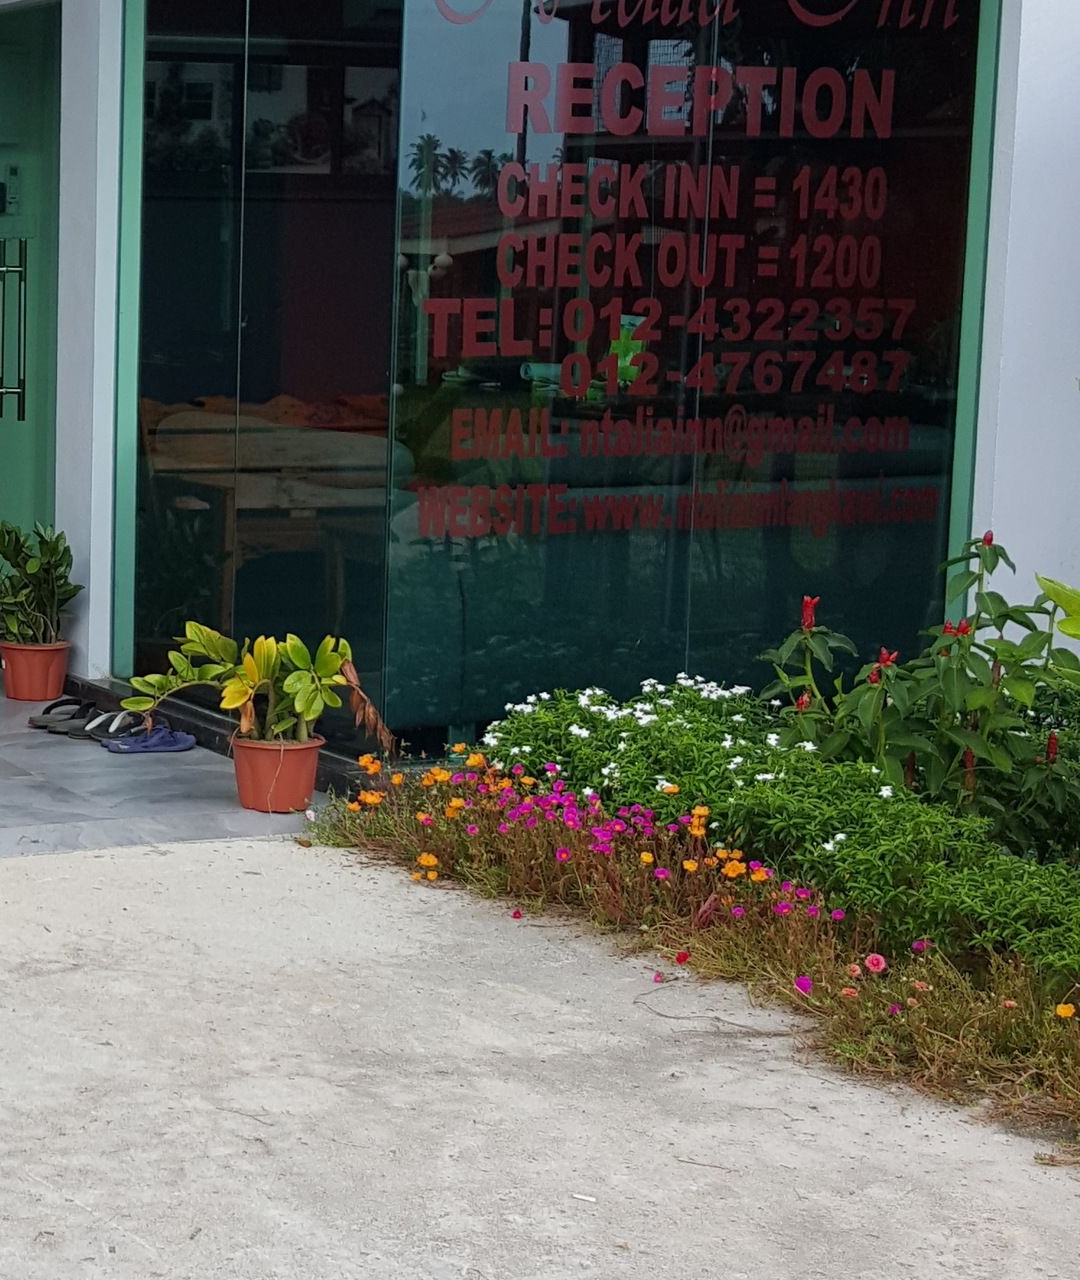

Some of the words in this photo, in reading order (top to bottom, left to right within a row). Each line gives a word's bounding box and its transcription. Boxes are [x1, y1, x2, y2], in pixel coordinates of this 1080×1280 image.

[505, 61, 896, 140] RECEPTION
[496, 161, 650, 219] CHECK
[663, 164, 740, 220] INN
[792, 165, 888, 220] 1430
[495, 231, 644, 289] CHECK
[657, 232, 746, 289] OUT
[789, 233, 882, 289] 1200
[423, 297, 553, 358] TEL:
[562, 296, 918, 343] 012-4322357
[560, 349, 913, 398] 012-4767487
[451, 407, 569, 461] EMAIL:
[417, 483, 577, 538] WEBSITE:
